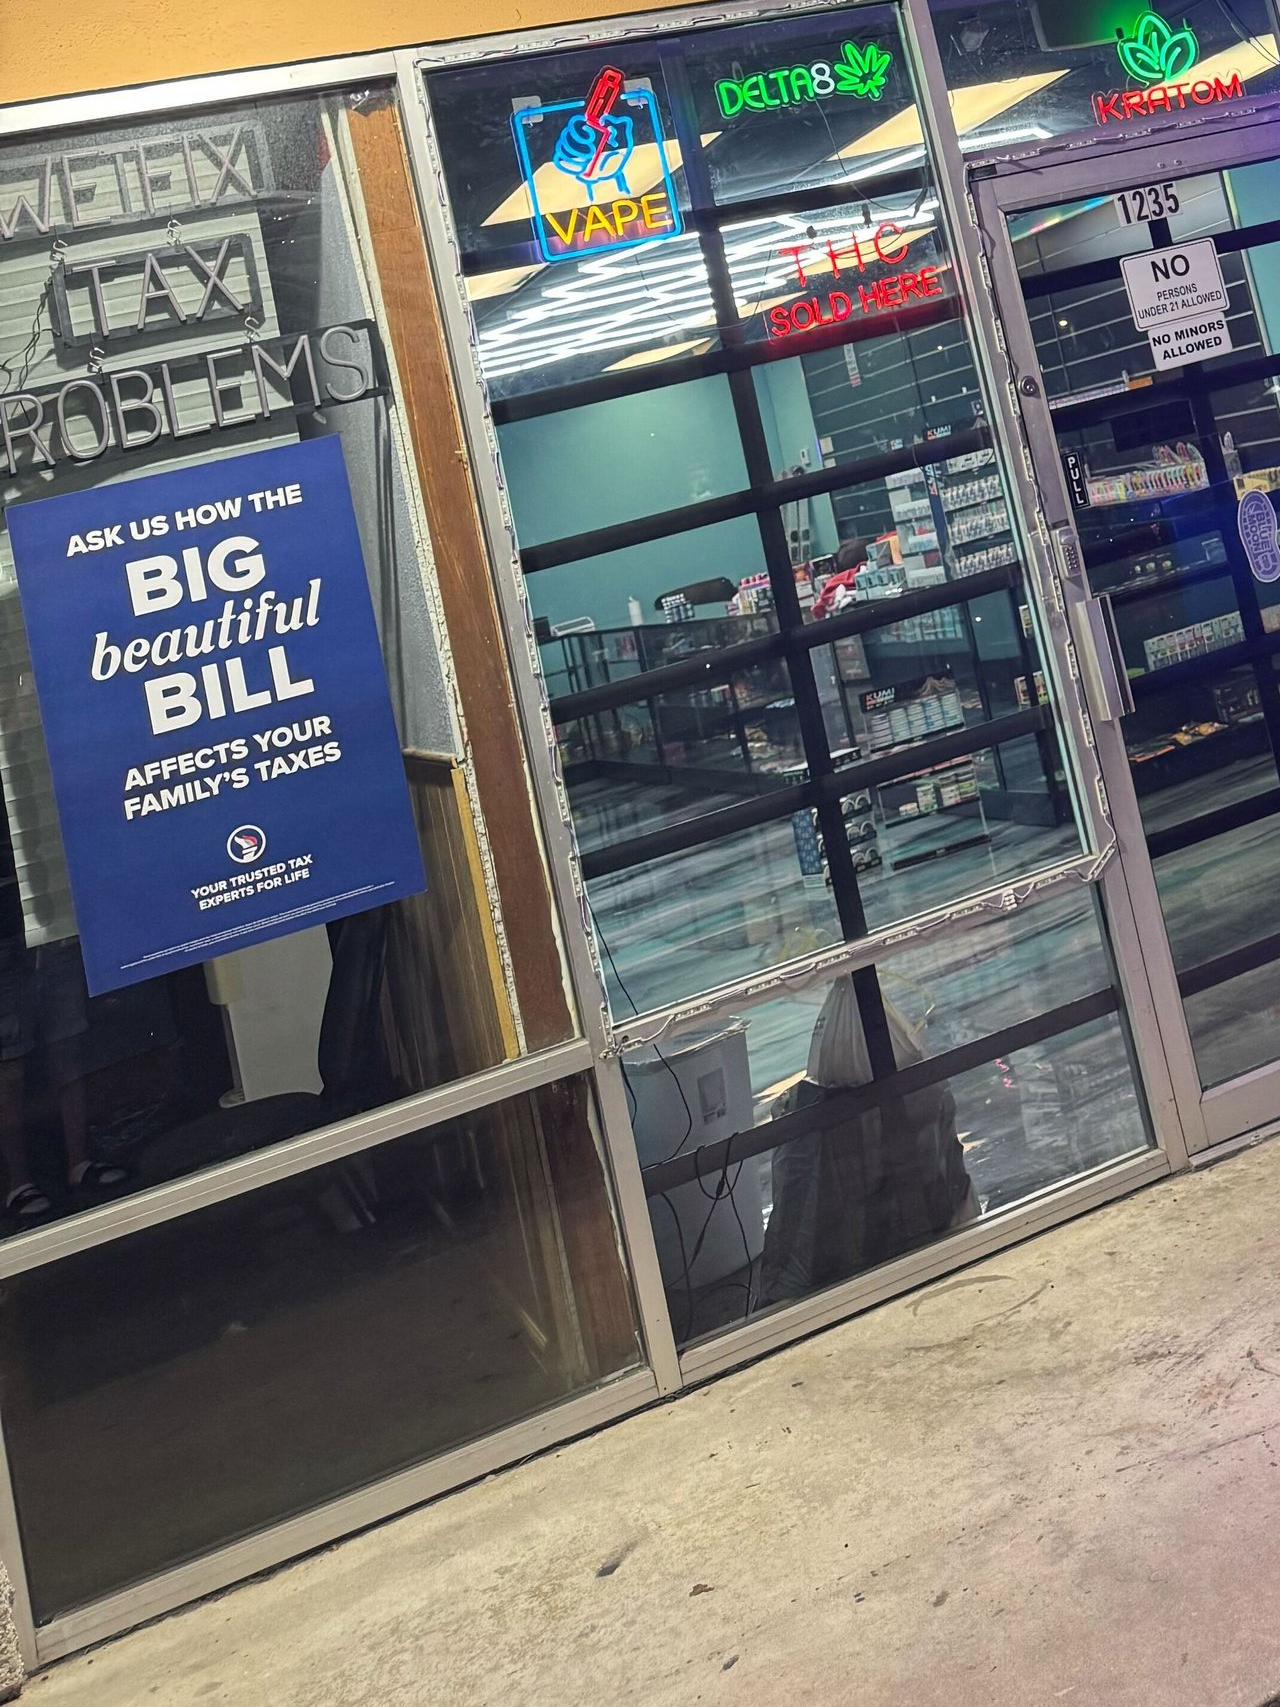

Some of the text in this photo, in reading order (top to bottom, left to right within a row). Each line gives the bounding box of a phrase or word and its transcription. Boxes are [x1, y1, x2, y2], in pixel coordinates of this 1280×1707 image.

[719, 61, 836, 117] DELTA8
[1097, 73, 1243, 124] KRATOM
[0, 126, 258, 239] WE FIX
[1117, 182, 1180, 226] 1235
[546, 192, 673, 245] VAPE
[779, 222, 908, 287] THC
[1150, 254, 1190, 283] NO
[72, 238, 244, 337] TAX
[769, 265, 943, 337] SOLD HERE
[1137, 290, 1223, 320] UNDER 21 ALLOWED
[1156, 282, 1198, 302] PERSONS
[1151, 319, 1225, 347] NO MINORS
[1162, 335, 1223, 361] ALLOWED
[0, 325, 370, 475] ROBLEMS
[1067, 456, 1084, 504] PULL
[66, 483, 303, 557] ASK US HOW THE
[1247, 514, 1261, 552] MOON
[1256, 512, 1270, 551] BLUE
[125, 535, 266, 617] BIG
[91, 578, 322, 681] beautiful
[144, 645, 315, 735] BILL
[124, 715, 333, 791] AFFECTS YOUR
[123, 741, 342, 821] FAMILY'S TAXES
[190, 854, 313, 899] YOUR TRUSTED TAX
[199, 868, 311, 911] EXPERTS FOR LIFE
